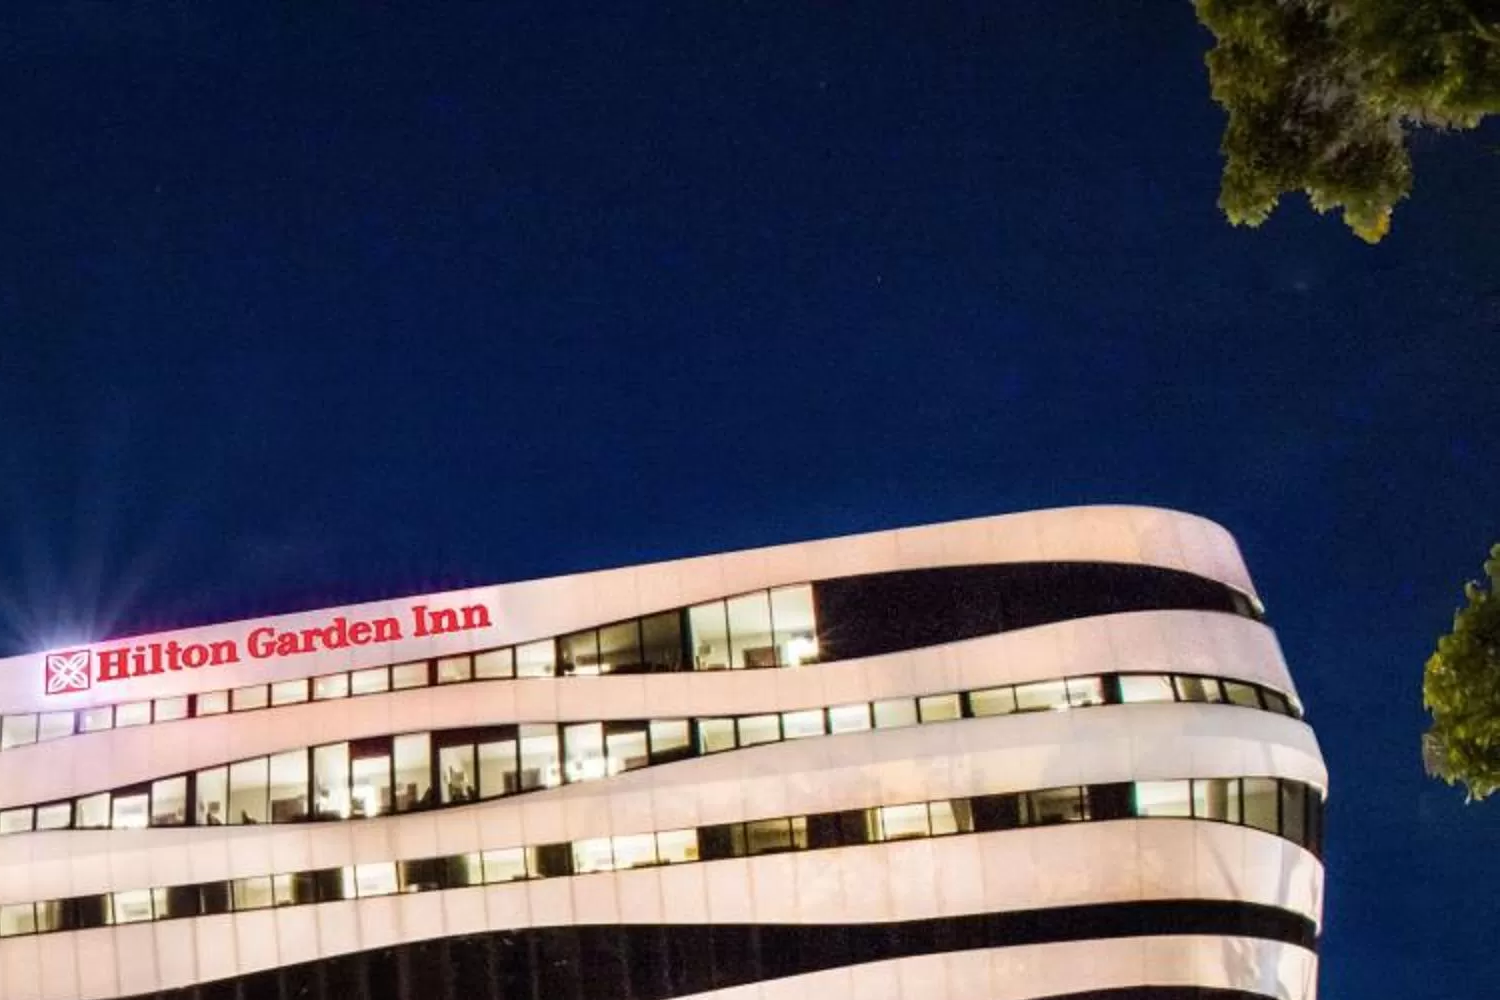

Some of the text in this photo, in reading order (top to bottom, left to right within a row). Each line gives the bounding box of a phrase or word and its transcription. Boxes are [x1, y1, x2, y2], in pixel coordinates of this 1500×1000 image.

[96, 603, 492, 682] Hilton Garden Inn
